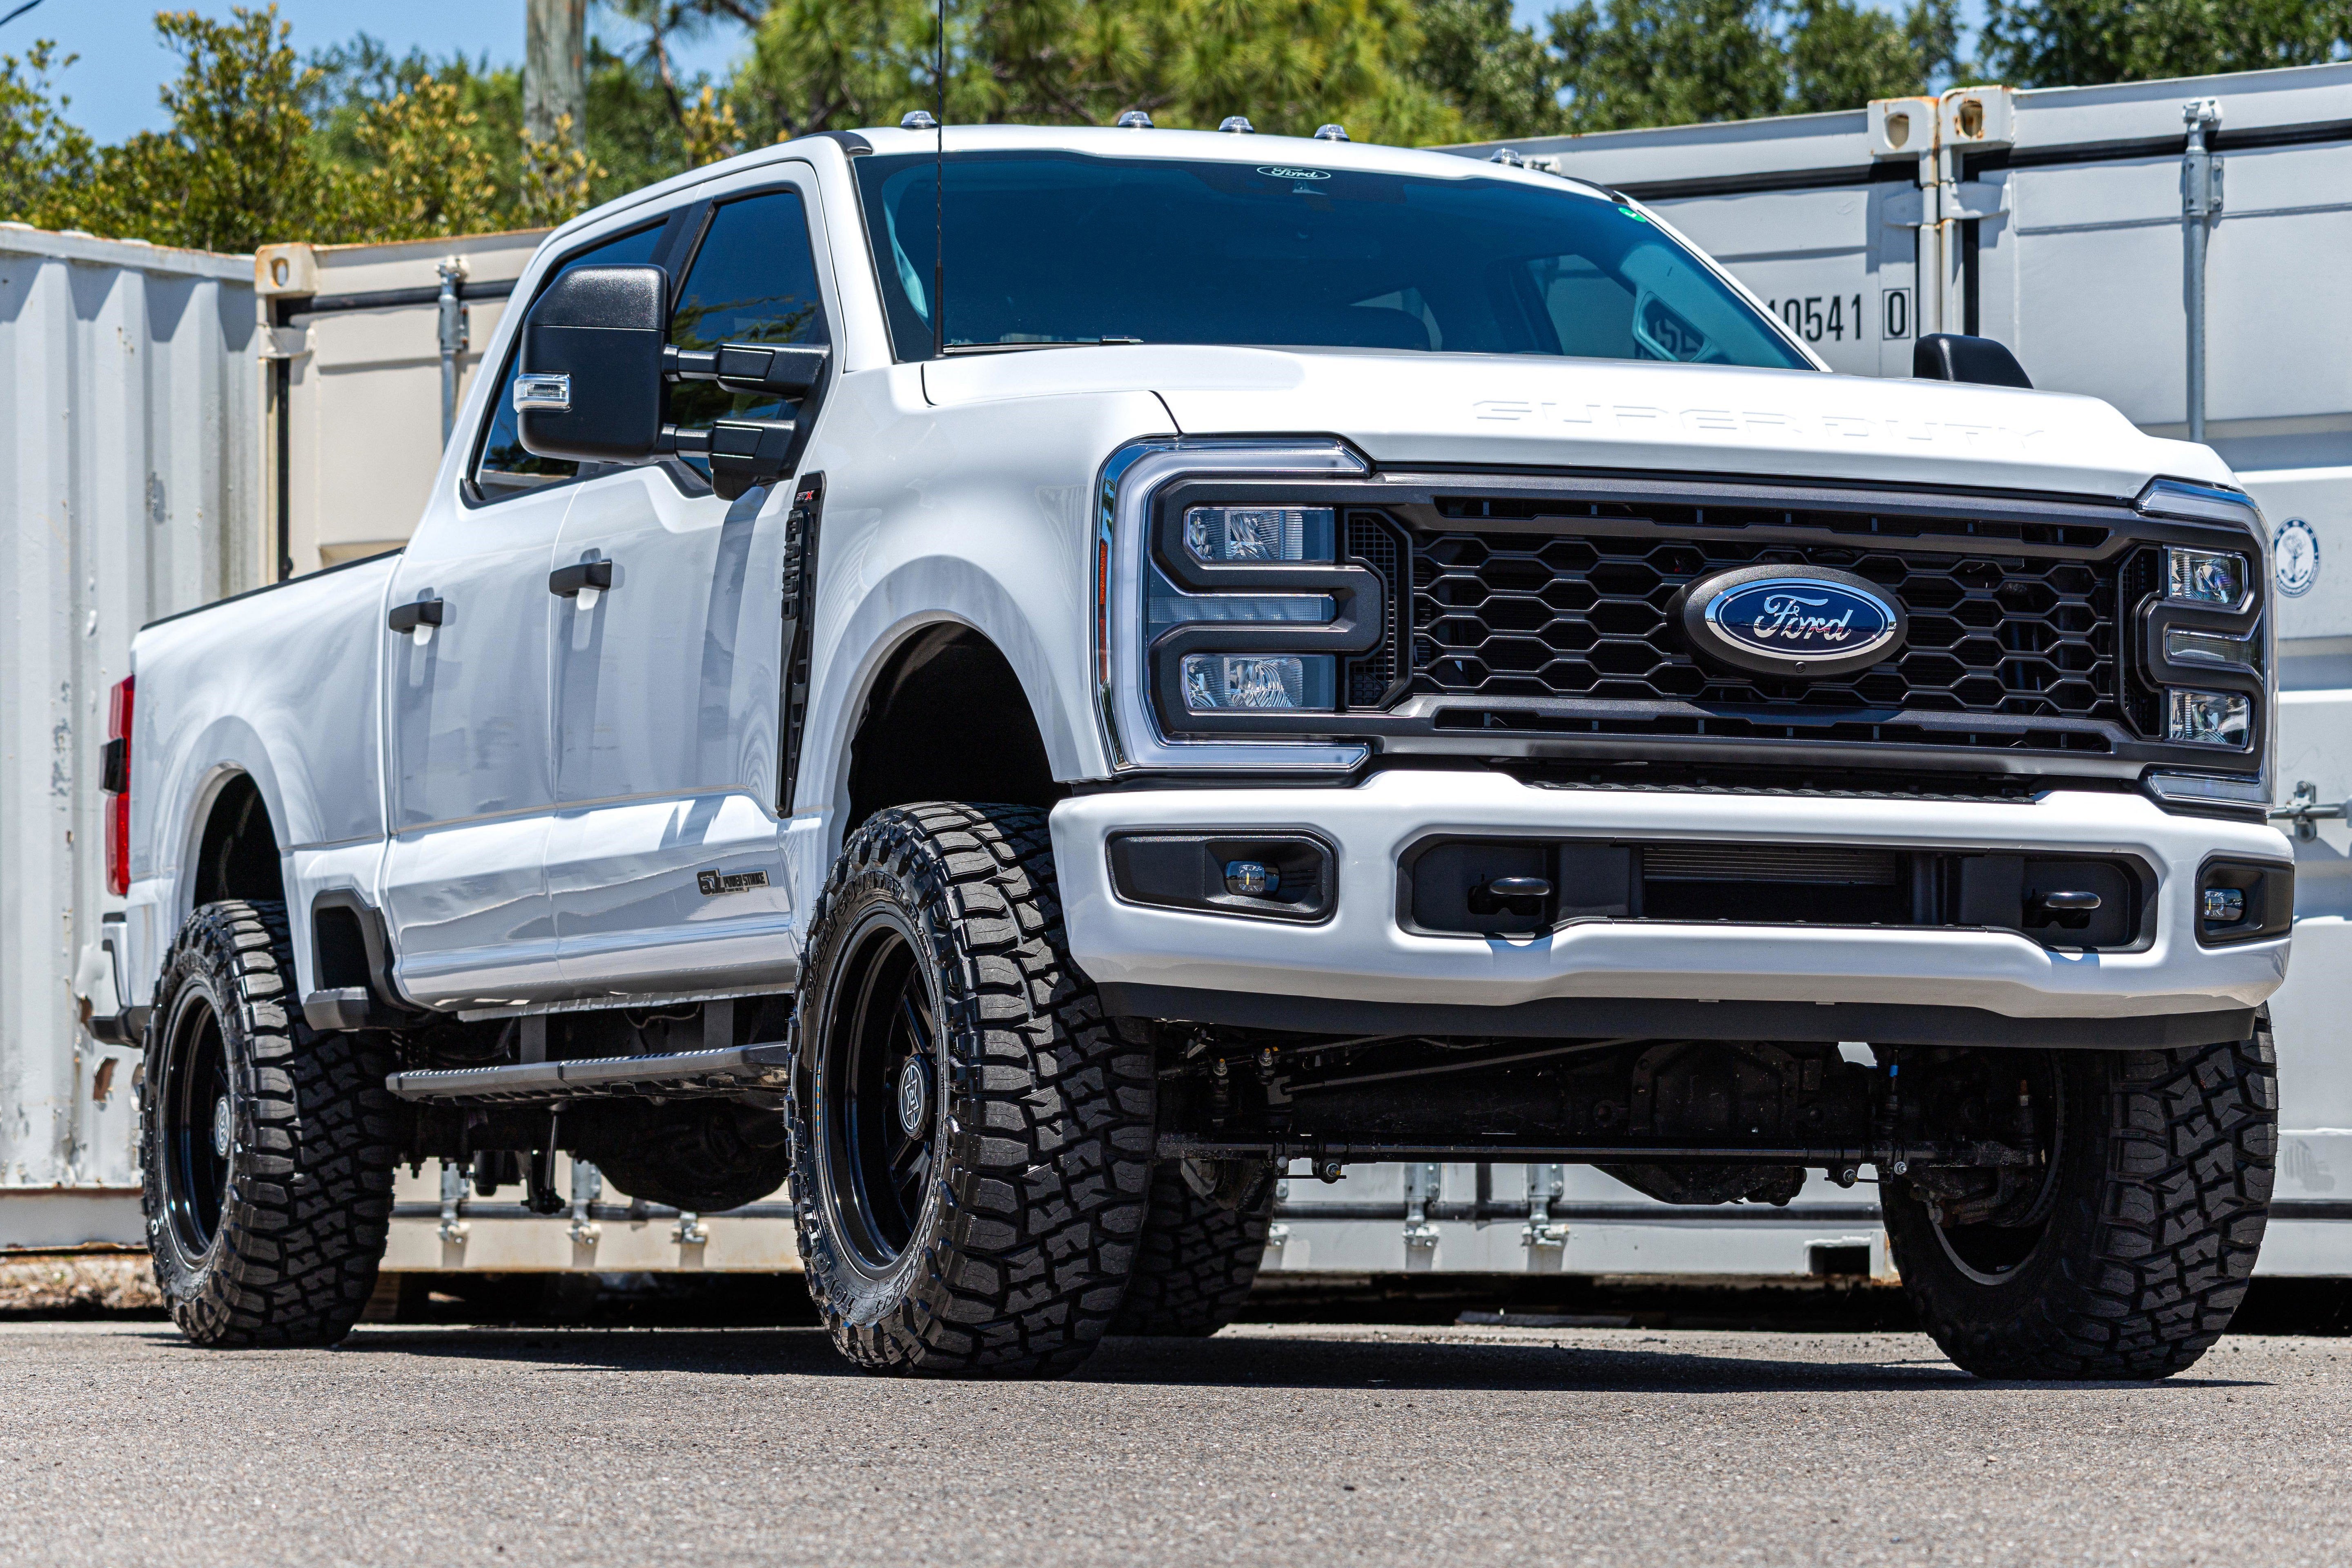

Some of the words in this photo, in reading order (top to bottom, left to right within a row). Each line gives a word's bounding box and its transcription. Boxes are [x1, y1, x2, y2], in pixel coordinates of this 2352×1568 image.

[1271, 167, 1319, 178] Ford
[1888, 291, 1906, 336] 0
[1472, 400, 1804, 434] SUPER
[1822, 415, 2045, 449] DUTY
[796, 490, 814, 501] STX
[1753, 594, 1854, 641] Ford
[723, 875, 743, 888] POWER
[742, 872, 766, 886] STROKE
[805, 913, 835, 1007] OPEN
[835, 871, 905, 915] COUNTRY
[813, 1251, 856, 1316] TOYO
